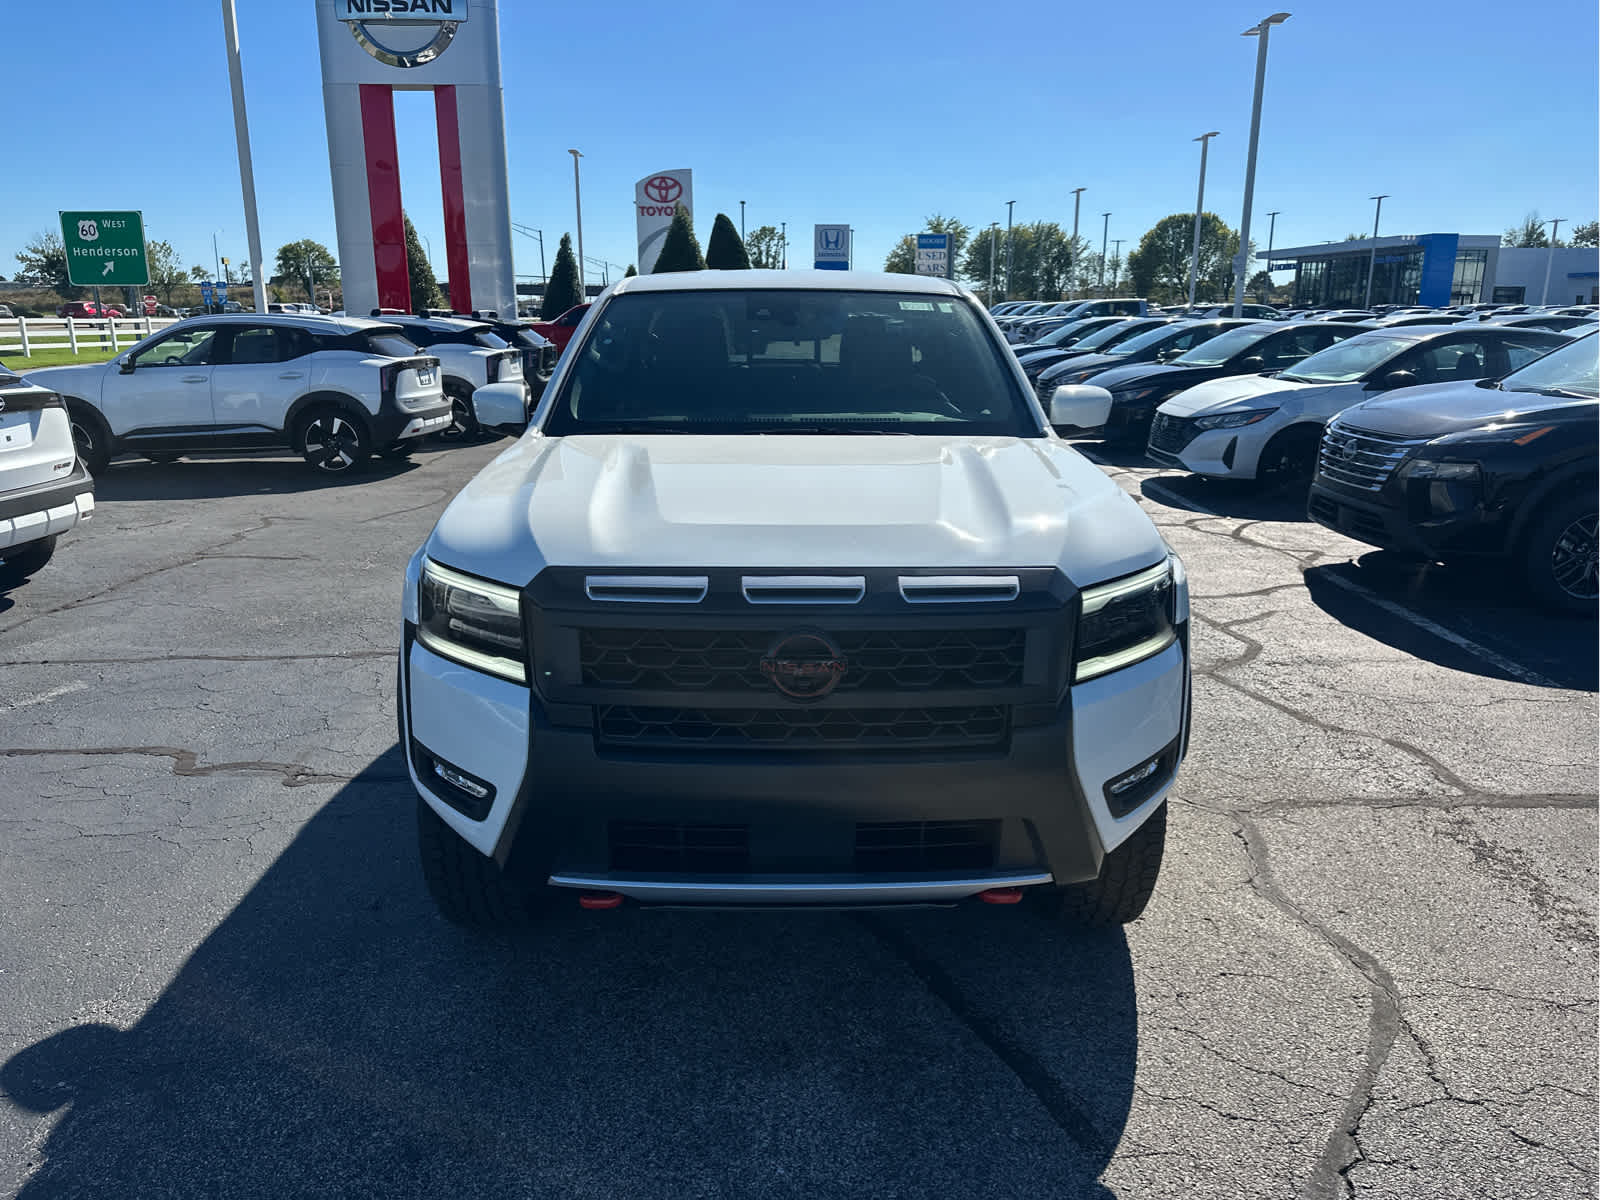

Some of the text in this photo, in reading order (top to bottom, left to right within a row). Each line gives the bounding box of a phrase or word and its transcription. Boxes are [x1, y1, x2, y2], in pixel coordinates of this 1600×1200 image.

[347, 0, 453, 13] NISSAN
[638, 206, 689, 216] TOYO
[102, 220, 126, 228] WEST
[81, 224, 96, 236] 60
[73, 246, 138, 257] Henderson
[918, 251, 946, 261] USED
[917, 263, 946, 273] CARS
[762, 661, 846, 673] NISSAN
